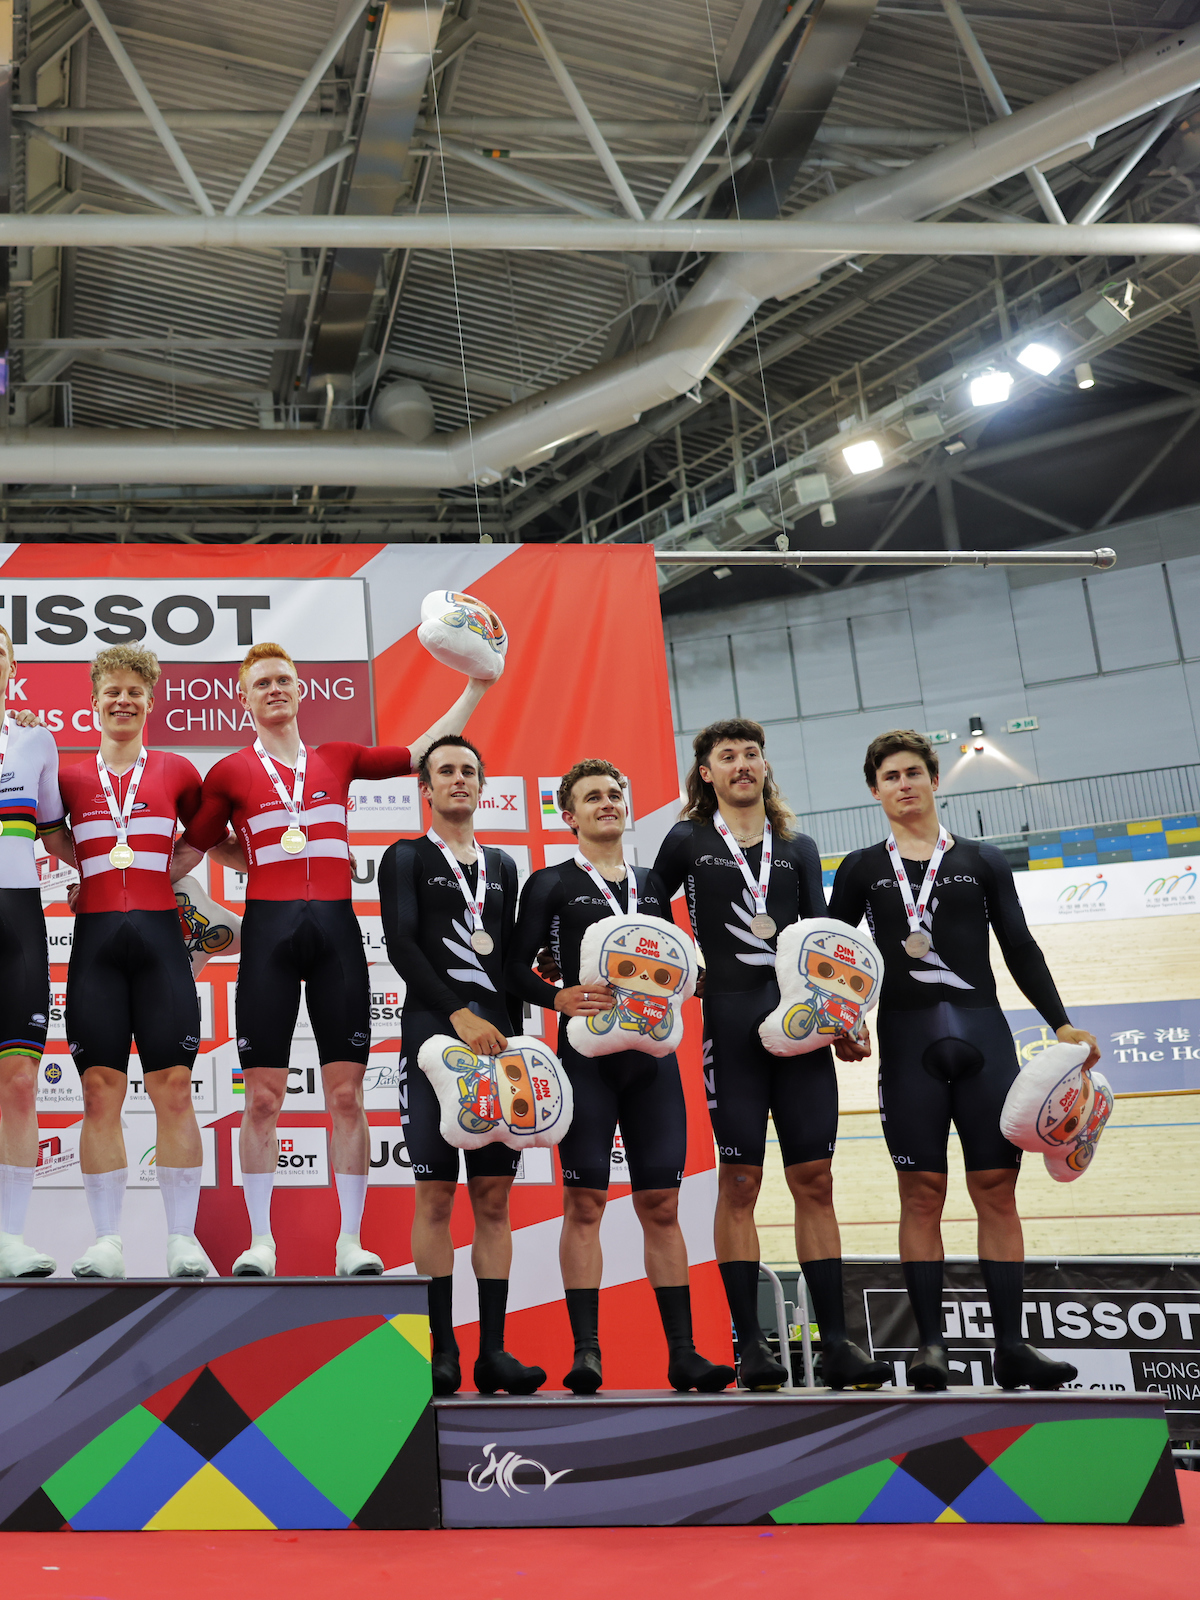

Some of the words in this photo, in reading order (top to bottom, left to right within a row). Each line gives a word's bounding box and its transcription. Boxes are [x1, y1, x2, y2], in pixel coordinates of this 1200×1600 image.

[166, 677, 242, 701] HON
[166, 708, 256, 732] CHINA
[82, 810, 112, 818] postno
[714, 857, 738, 865] CYCLIN
[935, 876, 952, 887] LE
[954, 874, 979, 886] COL
[638, 937, 659, 950] DIN
[836, 943, 854, 957] DIN
[642, 1007, 663, 1019] HKG
[839, 1010, 854, 1025] HKG
[1110, 1027, 1200, 1046] 香港
[1113, 1047, 1165, 1063] The
[539, 1079, 551, 1098] DIN
[1059, 1087, 1075, 1107] DIN
[479, 1095, 488, 1118] HKG
[369, 1141, 413, 1168] UC
[1142, 1361, 1200, 1379] HONG
